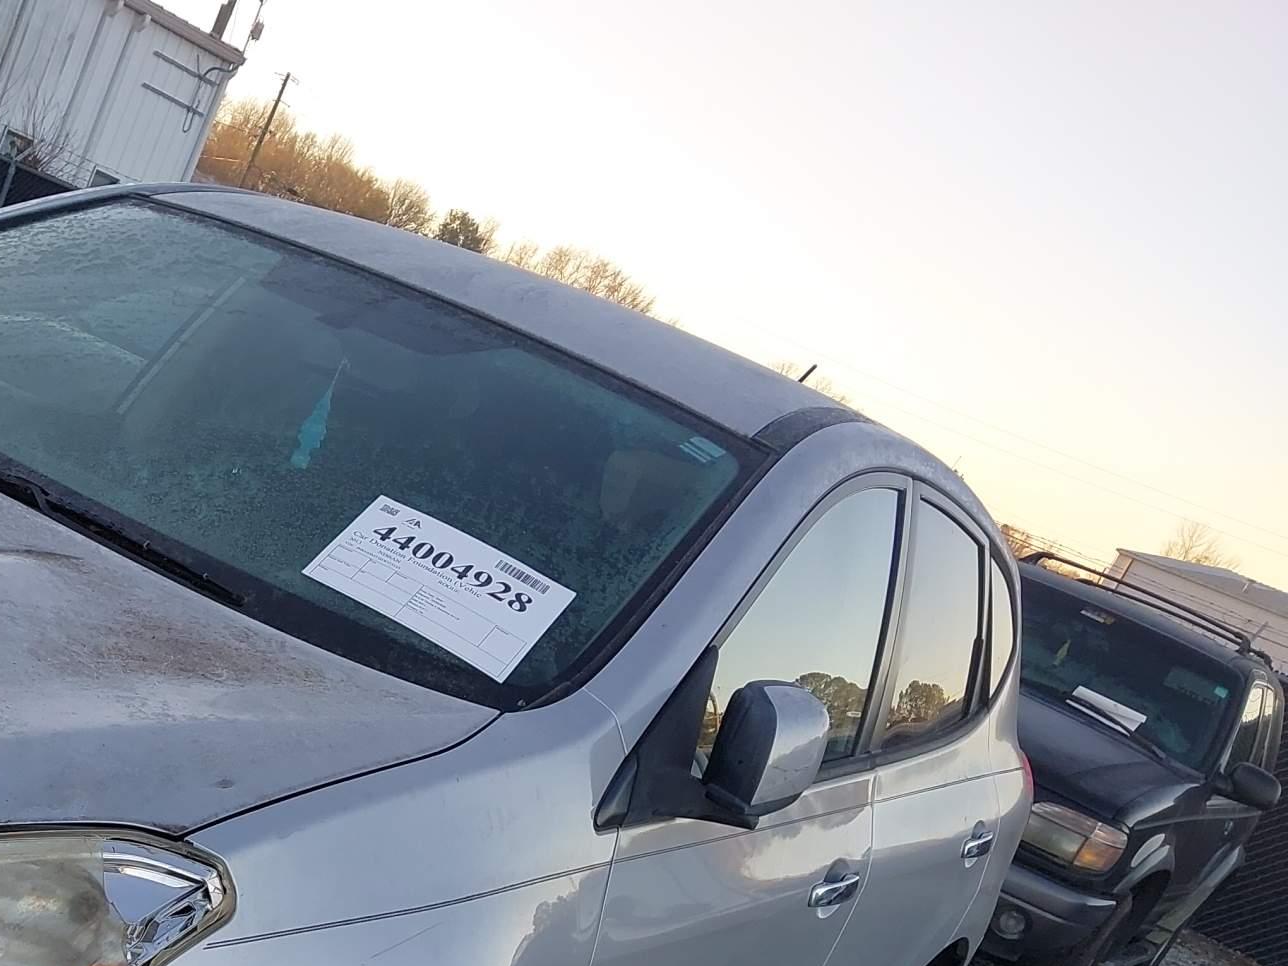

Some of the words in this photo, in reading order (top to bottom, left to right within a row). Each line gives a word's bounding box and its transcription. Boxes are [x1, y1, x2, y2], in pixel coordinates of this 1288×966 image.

[353, 530, 369, 541] Car
[369, 537, 407, 560] Donation
[407, 555, 454, 584] Foundation
[453, 576, 482, 598] (Vehic
[372, 526, 533, 613] 44004928
